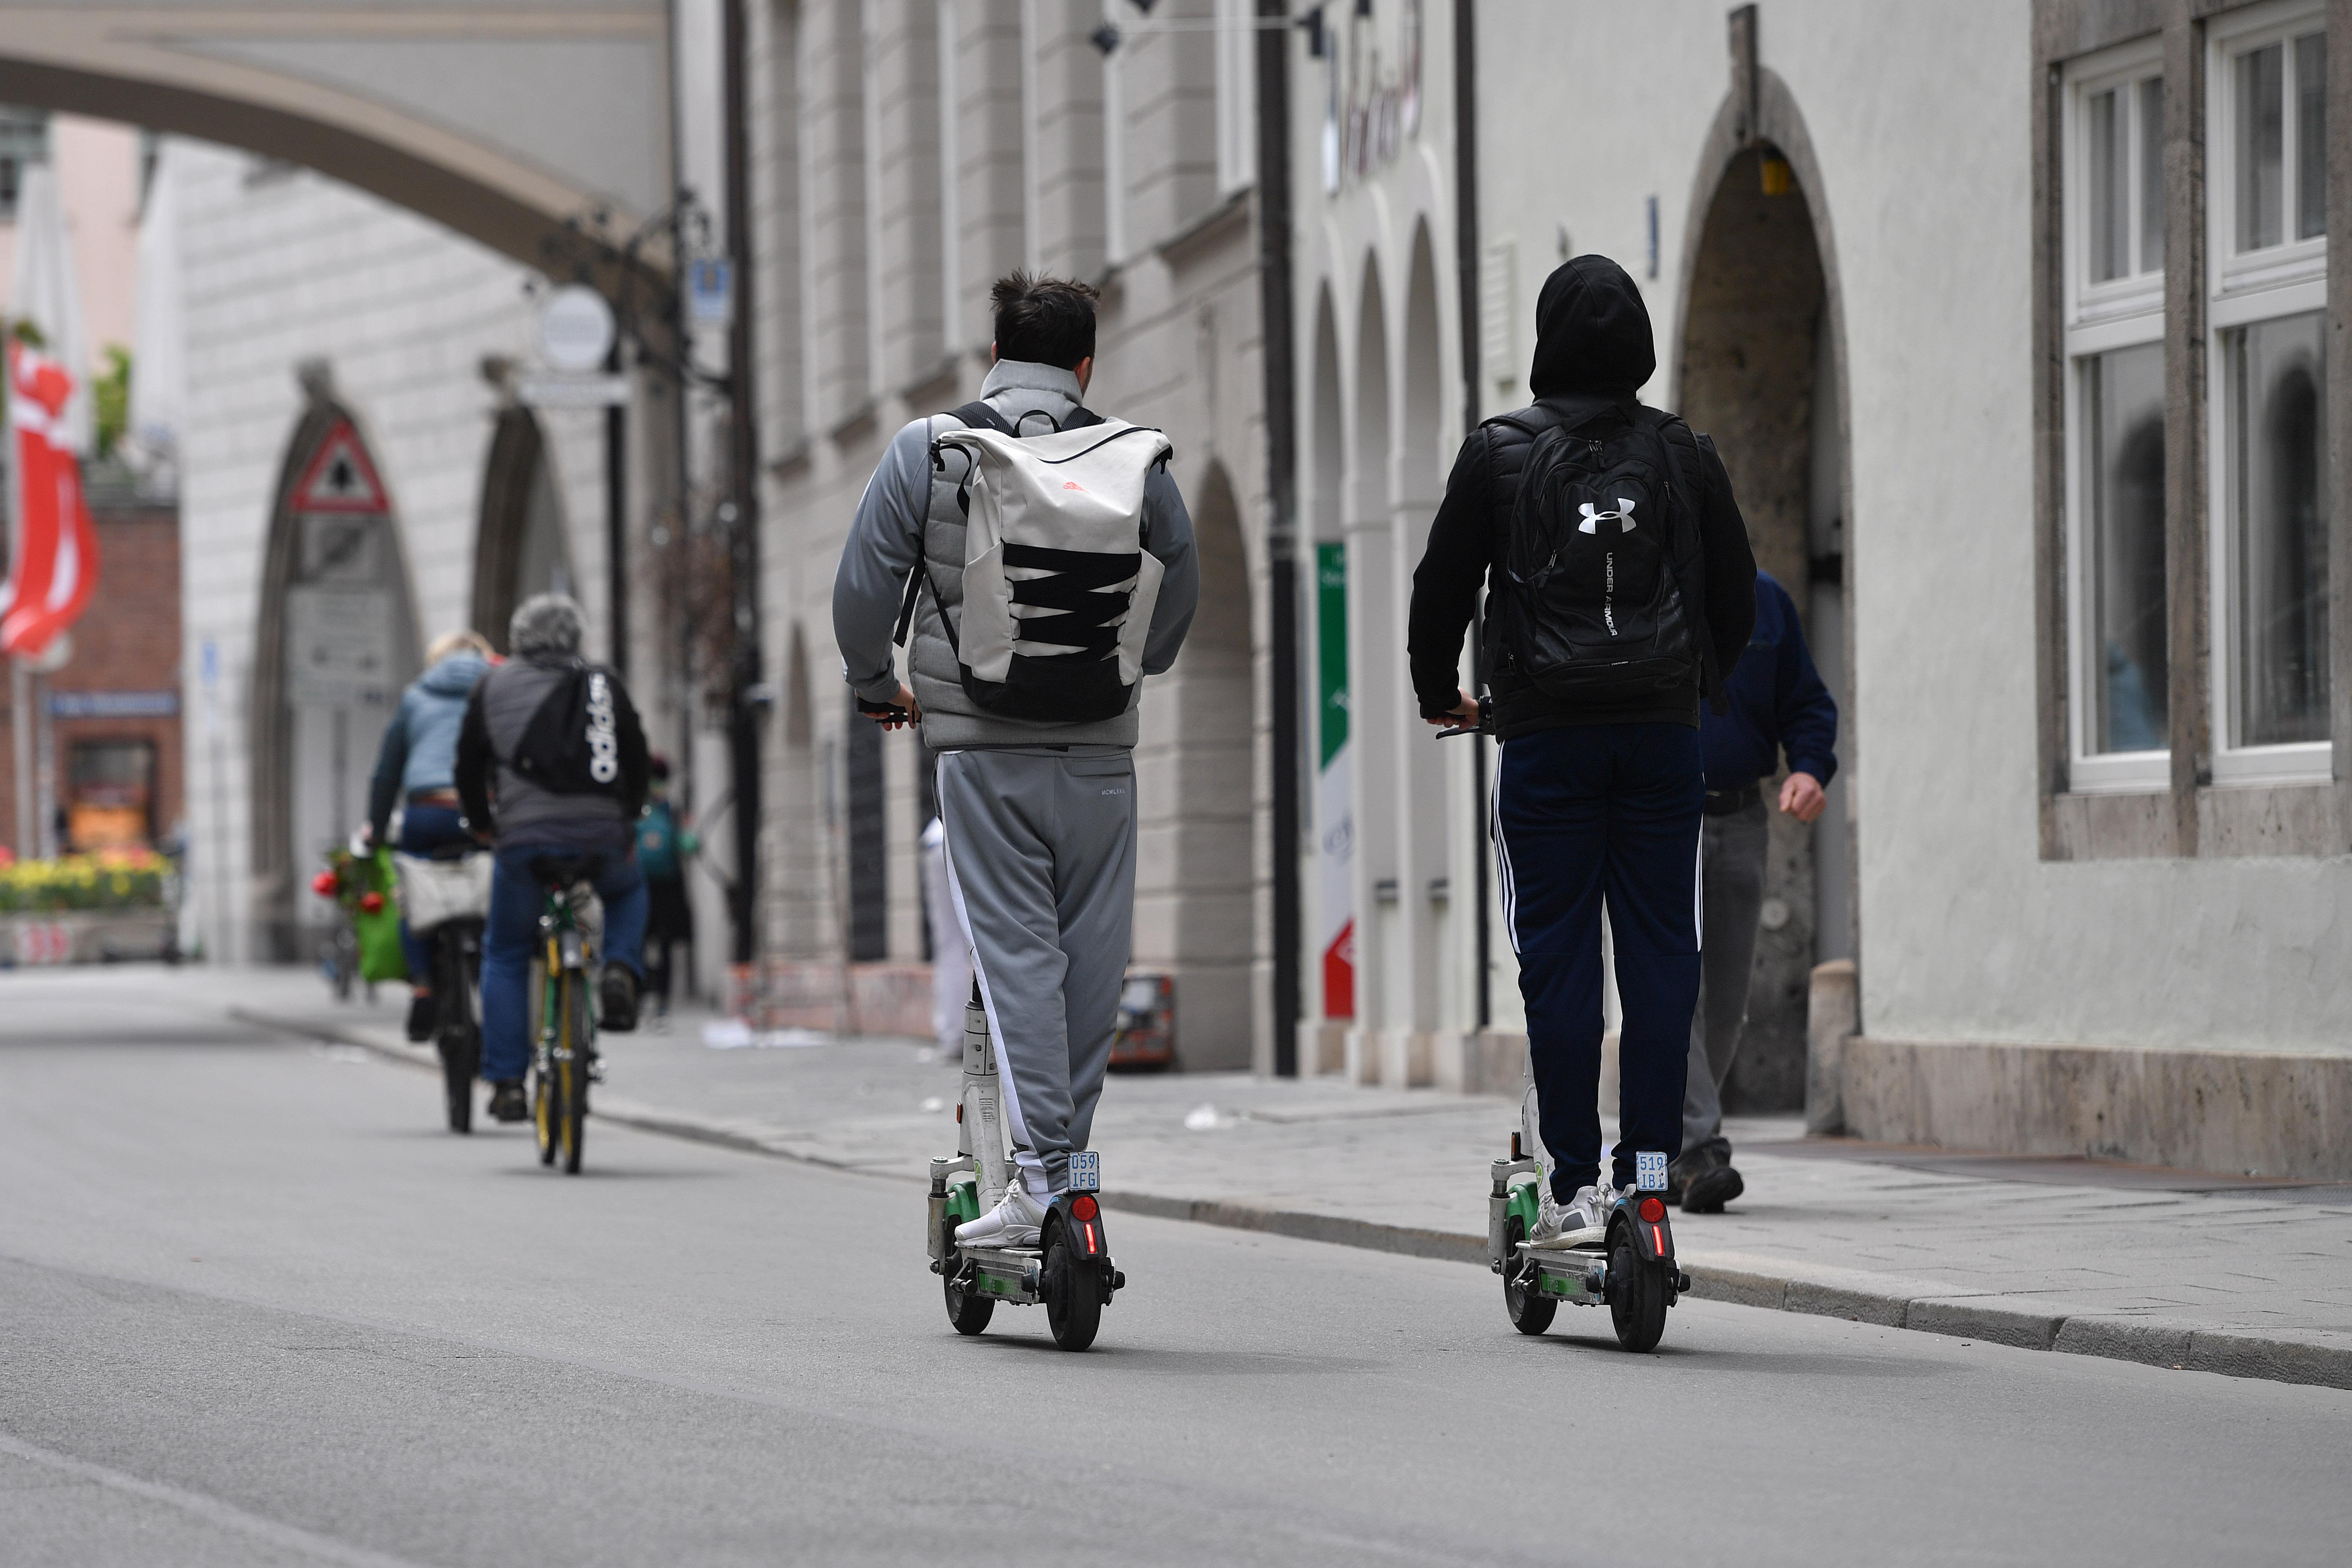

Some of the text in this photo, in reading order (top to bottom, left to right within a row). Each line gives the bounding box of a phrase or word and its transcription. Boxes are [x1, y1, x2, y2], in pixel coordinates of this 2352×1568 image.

[1604, 596, 1618, 636] ARMOUR
[1072, 1154, 1095, 1169] 059
[1640, 1156, 1663, 1170] 519
[1073, 1172, 1095, 1187] IFG
